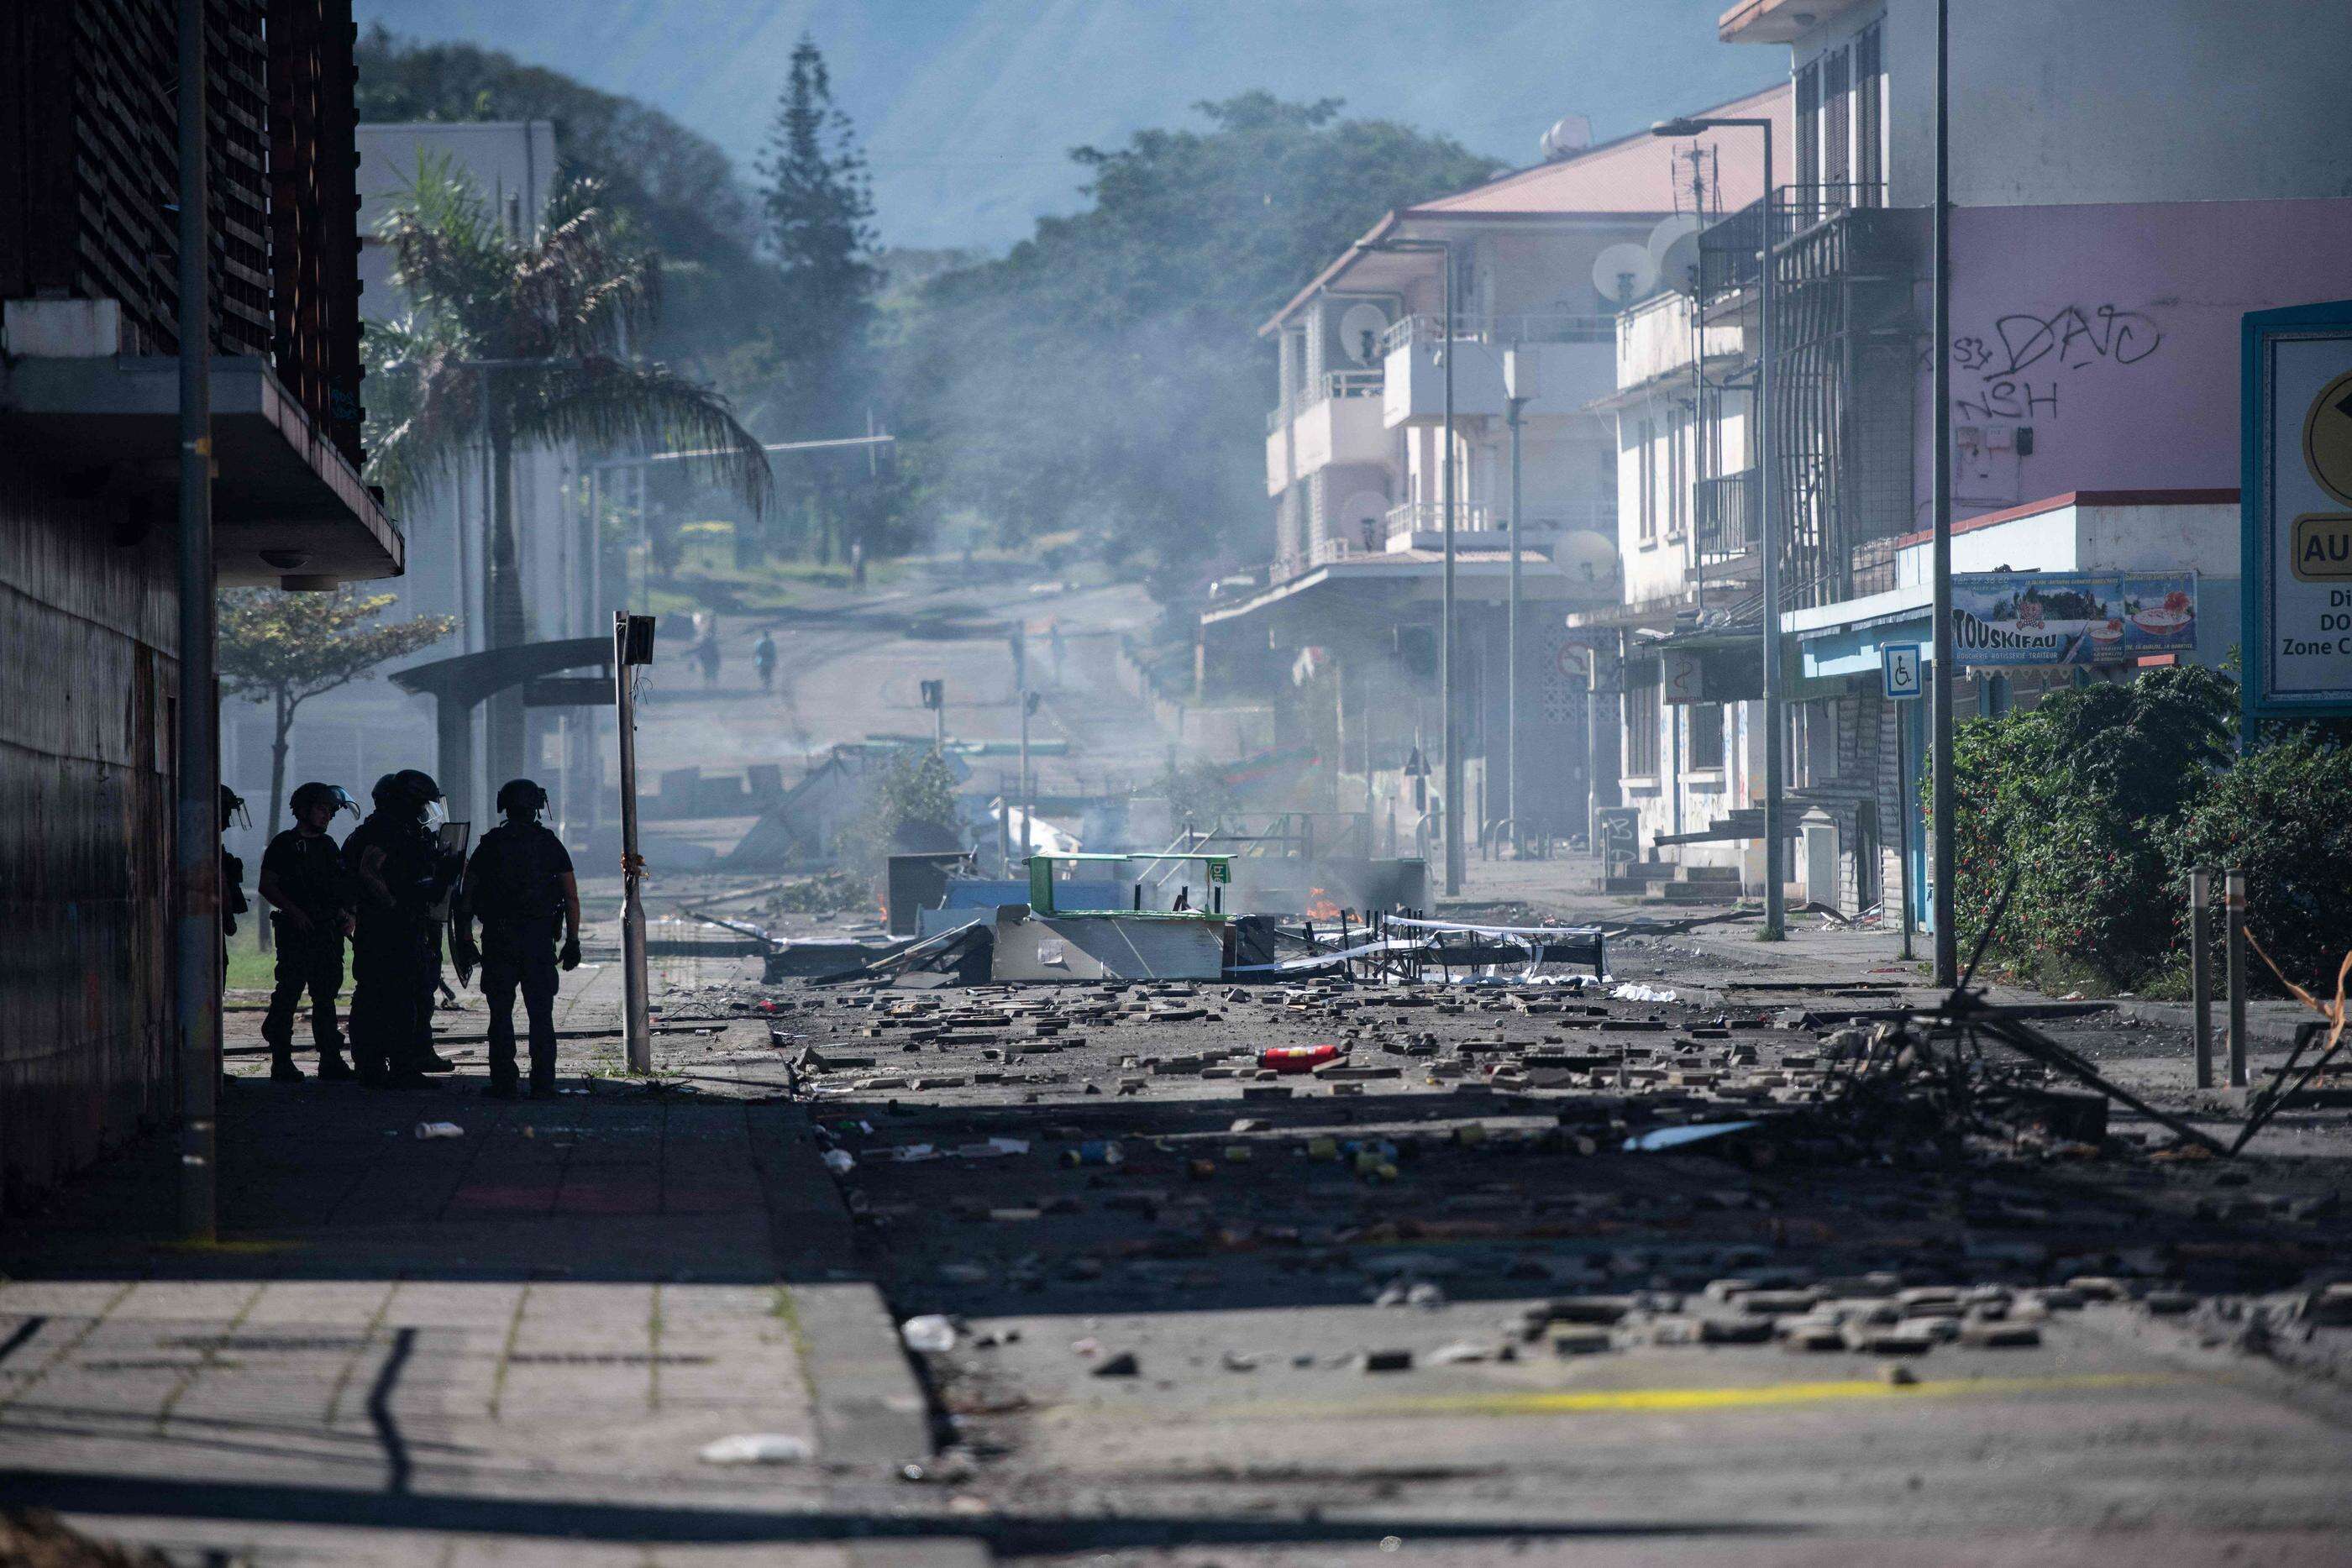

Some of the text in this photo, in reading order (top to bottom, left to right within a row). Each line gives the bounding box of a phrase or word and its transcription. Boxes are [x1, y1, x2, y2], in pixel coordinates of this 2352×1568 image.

[1952, 609, 2057, 649] TOUSKIFAU
[2029, 651, 2058, 659] TRAITEUR
[2283, 639, 2333, 655] Zone
